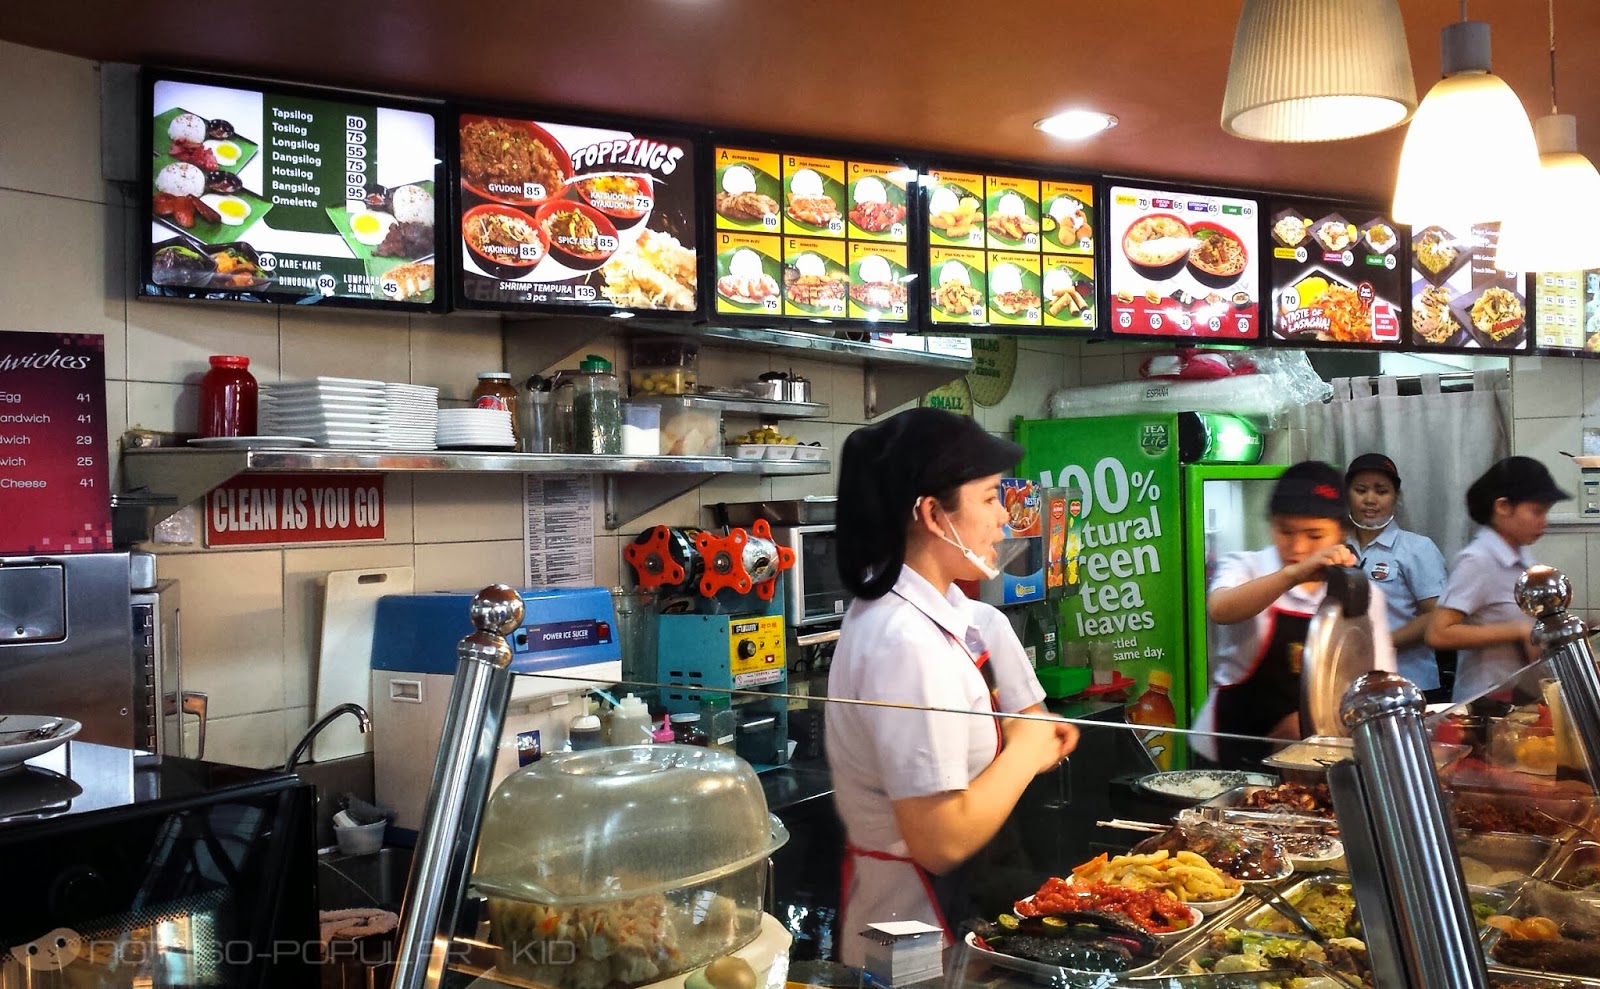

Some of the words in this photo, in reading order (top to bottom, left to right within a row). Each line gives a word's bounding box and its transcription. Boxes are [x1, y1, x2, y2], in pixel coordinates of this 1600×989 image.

[272, 108, 313, 123] Tapsilog
[348, 118, 363, 129] 80
[272, 122, 307, 136] Tosilog
[348, 132, 363, 143] 75
[272, 137, 320, 152] Longsilog
[348, 146, 363, 157] 55
[721, 150, 729, 160] A
[272, 152, 322, 167] Dangsilog
[571, 139, 685, 176] TOPPINGS
[789, 157, 796, 167] B
[348, 160, 363, 171] 75
[852, 164, 860, 174] C
[272, 166, 314, 181] Hotsilog
[348, 174, 363, 185] 60
[990, 178, 997, 187] H
[272, 180, 321, 195] Bangsilog
[488, 183, 522, 194] GYUDON
[526, 186, 541, 196] 85
[348, 188, 363, 199] 95
[272, 195, 318, 209] Omelette
[636, 198, 649, 208] 75
[1139, 198, 1147, 207] 70
[1174, 202, 1183, 210] 65
[1209, 204, 1217, 212] 65
[765, 217, 777, 226] 80
[830, 222, 842, 231] 85
[893, 227, 903, 236] 75
[722, 235, 730, 244] D
[972, 233, 981, 241] 75
[1027, 236, 1037, 244] 60
[600, 239, 613, 247] 85
[789, 239, 796, 249] E
[1081, 240, 1090, 248] 75
[522, 247, 537, 256] 85
[853, 244, 859, 253] F
[934, 250, 940, 259] J
[992, 254, 999, 262] K
[260, 257, 276, 268] 80
[279, 260, 322, 271] KARE-KARE
[1047, 258, 1053, 266] L
[1386, 258, 1395, 266] 50
[319, 279, 334, 288] 80
[383, 283, 398, 292] 45
[500, 281, 533, 292] SHRIMP
[533, 283, 572, 294] TEMPURA
[577, 288, 595, 297] 135
[526, 293, 532, 301] 3
[532, 294, 547, 303] pcs
[1285, 296, 1296, 304] 70
[766, 300, 777, 309] 75
[894, 306, 904, 314] 75
[972, 309, 982, 317] 80
[1029, 311, 1038, 319] 85
[1084, 313, 1093, 321] 50
[1121, 316, 1130, 324] 65
[1286, 310, 1309, 323] TASTE
[1312, 308, 1324, 317] OF
[1151, 317, 1160, 325] 65
[1211, 320, 1220, 328] 55
[1239, 321, 1248, 329] 35
[76, 393, 91, 402] 41
[1146, 387, 1169, 399] ESPAÑA
[930, 395, 964, 410] SMALL
[0, 413, 50, 423] andwich
[77, 414, 92, 424] 41
[1144, 425, 1165, 433] TEA
[76, 436, 93, 445] 29
[1142, 436, 1167, 447] Life
[77, 457, 93, 466] 25
[1, 478, 47, 488] Cheese
[80, 479, 94, 487] 41
[213, 487, 277, 533] CLEAN
[281, 487, 308, 530] AS
[312, 487, 350, 529] YOU
[354, 486, 380, 528] GO
[1080, 506, 1162, 550] tural
[1079, 545, 1161, 584] reen
[1079, 581, 1145, 615] tea
[1076, 610, 1155, 638] leaves
[543, 632, 563, 641] POWER
[563, 631, 572, 639] ICE
[572, 629, 589, 638] SLICER
[1113, 650, 1141, 661] same
[1144, 646, 1165, 660] day.
